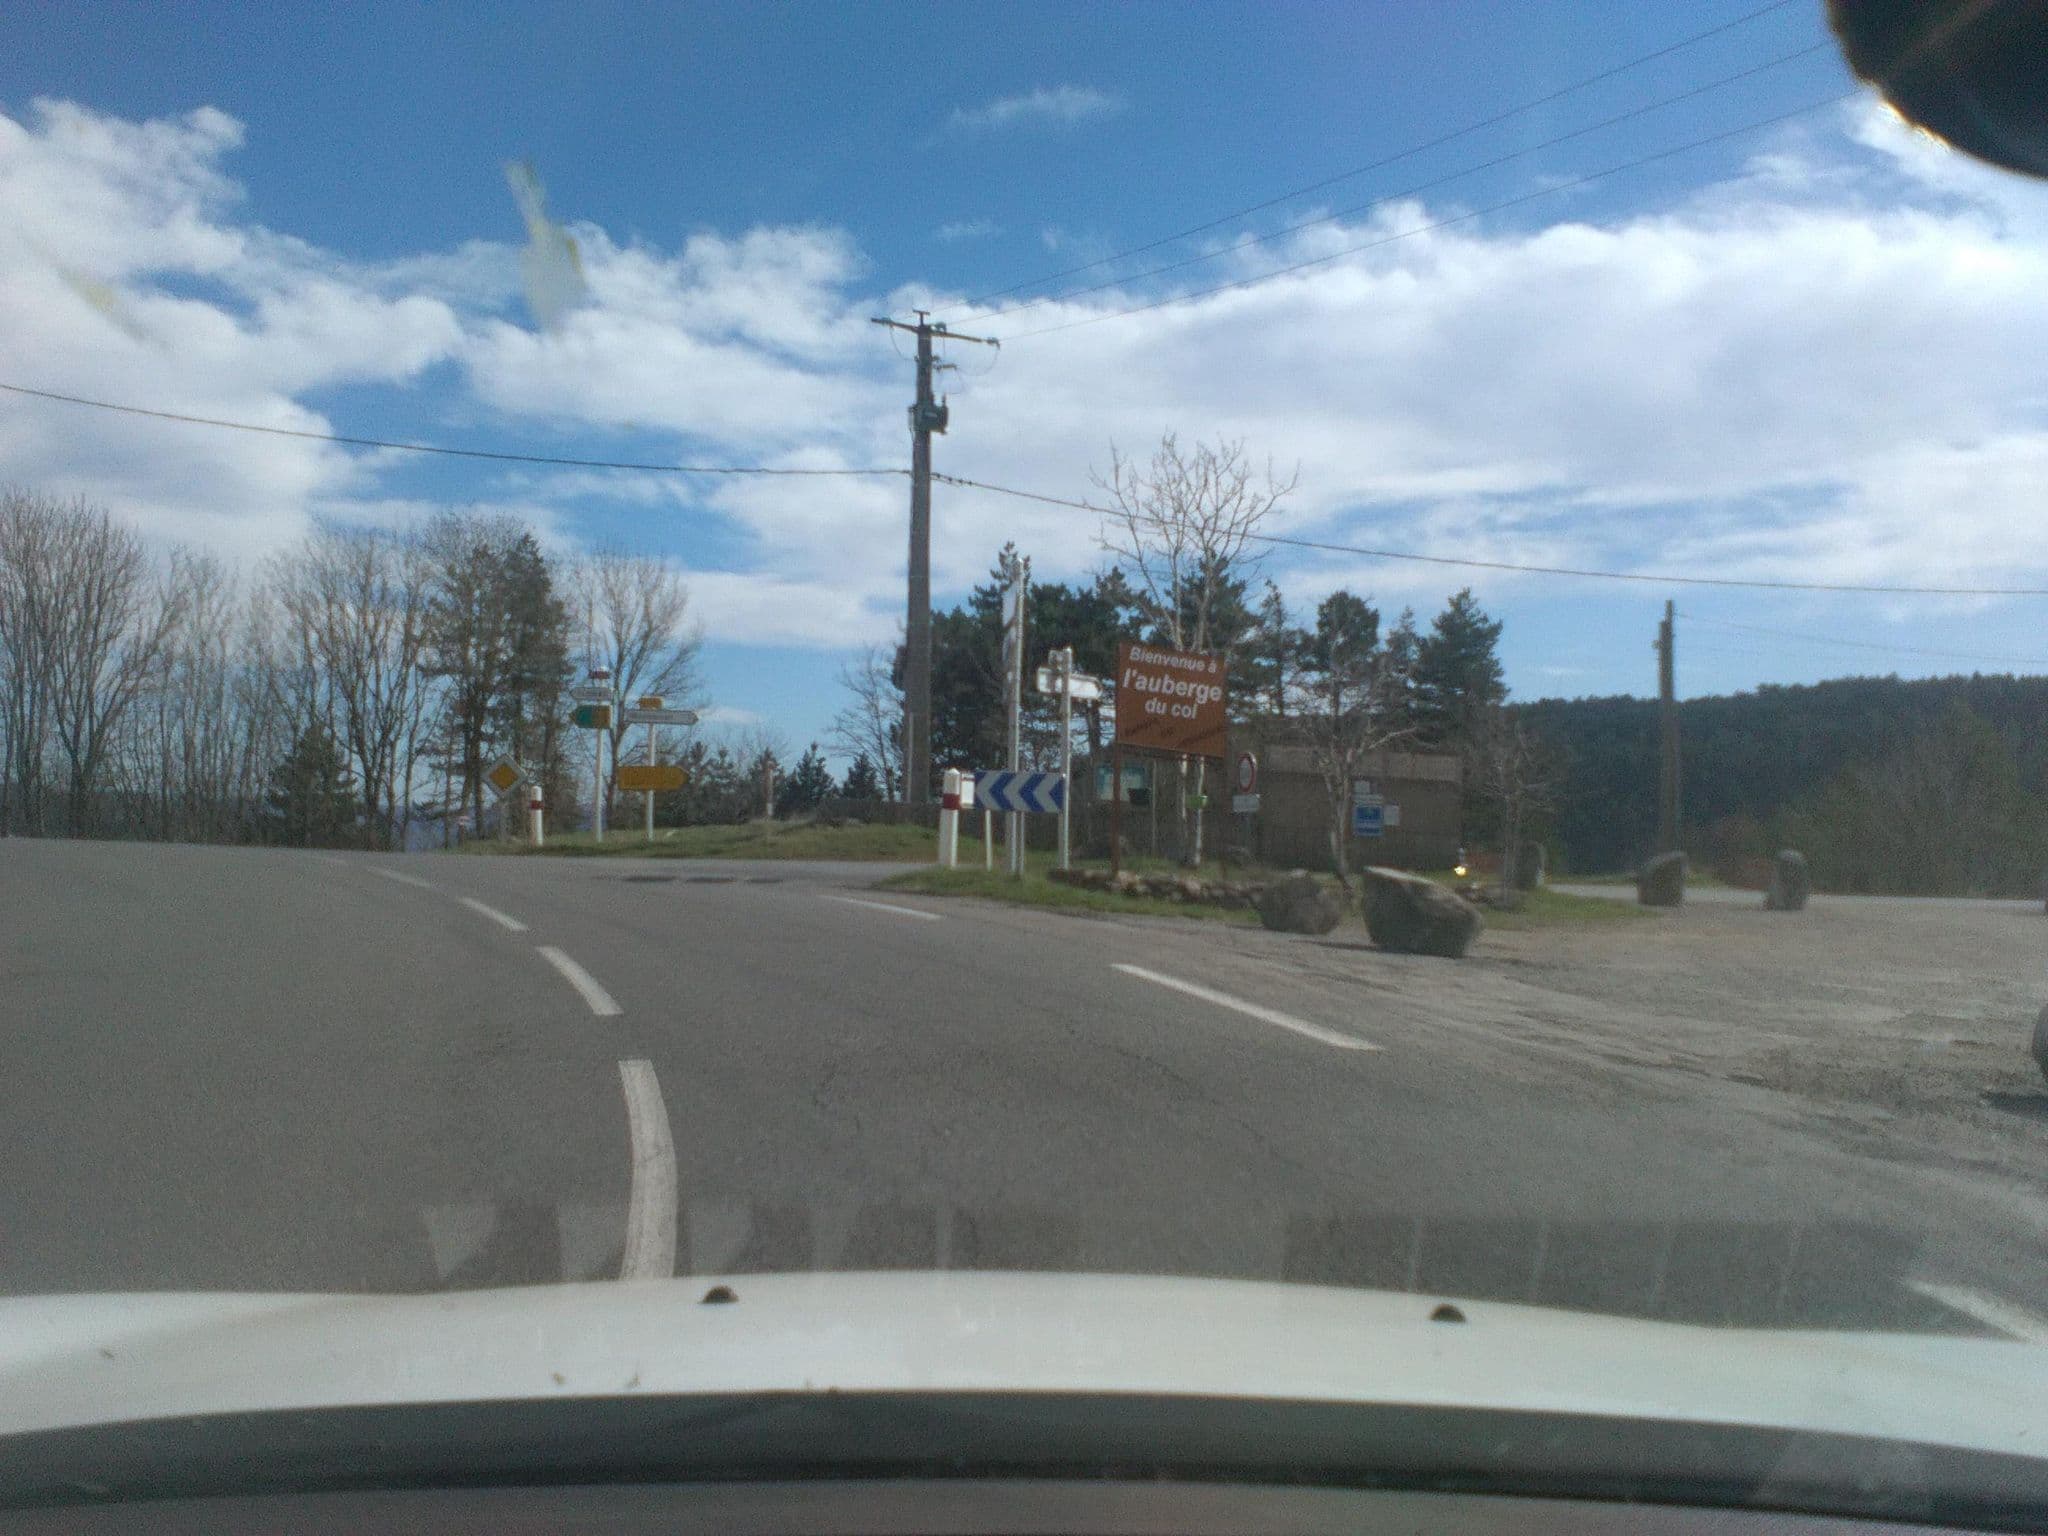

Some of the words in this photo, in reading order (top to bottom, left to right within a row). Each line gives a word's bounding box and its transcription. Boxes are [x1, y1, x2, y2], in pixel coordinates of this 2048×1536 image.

[1129, 646, 1205, 671] Bienvenue
[1122, 667, 1222, 704] l'auberge
[1144, 697, 1167, 715] du
[1170, 703, 1198, 719] col
